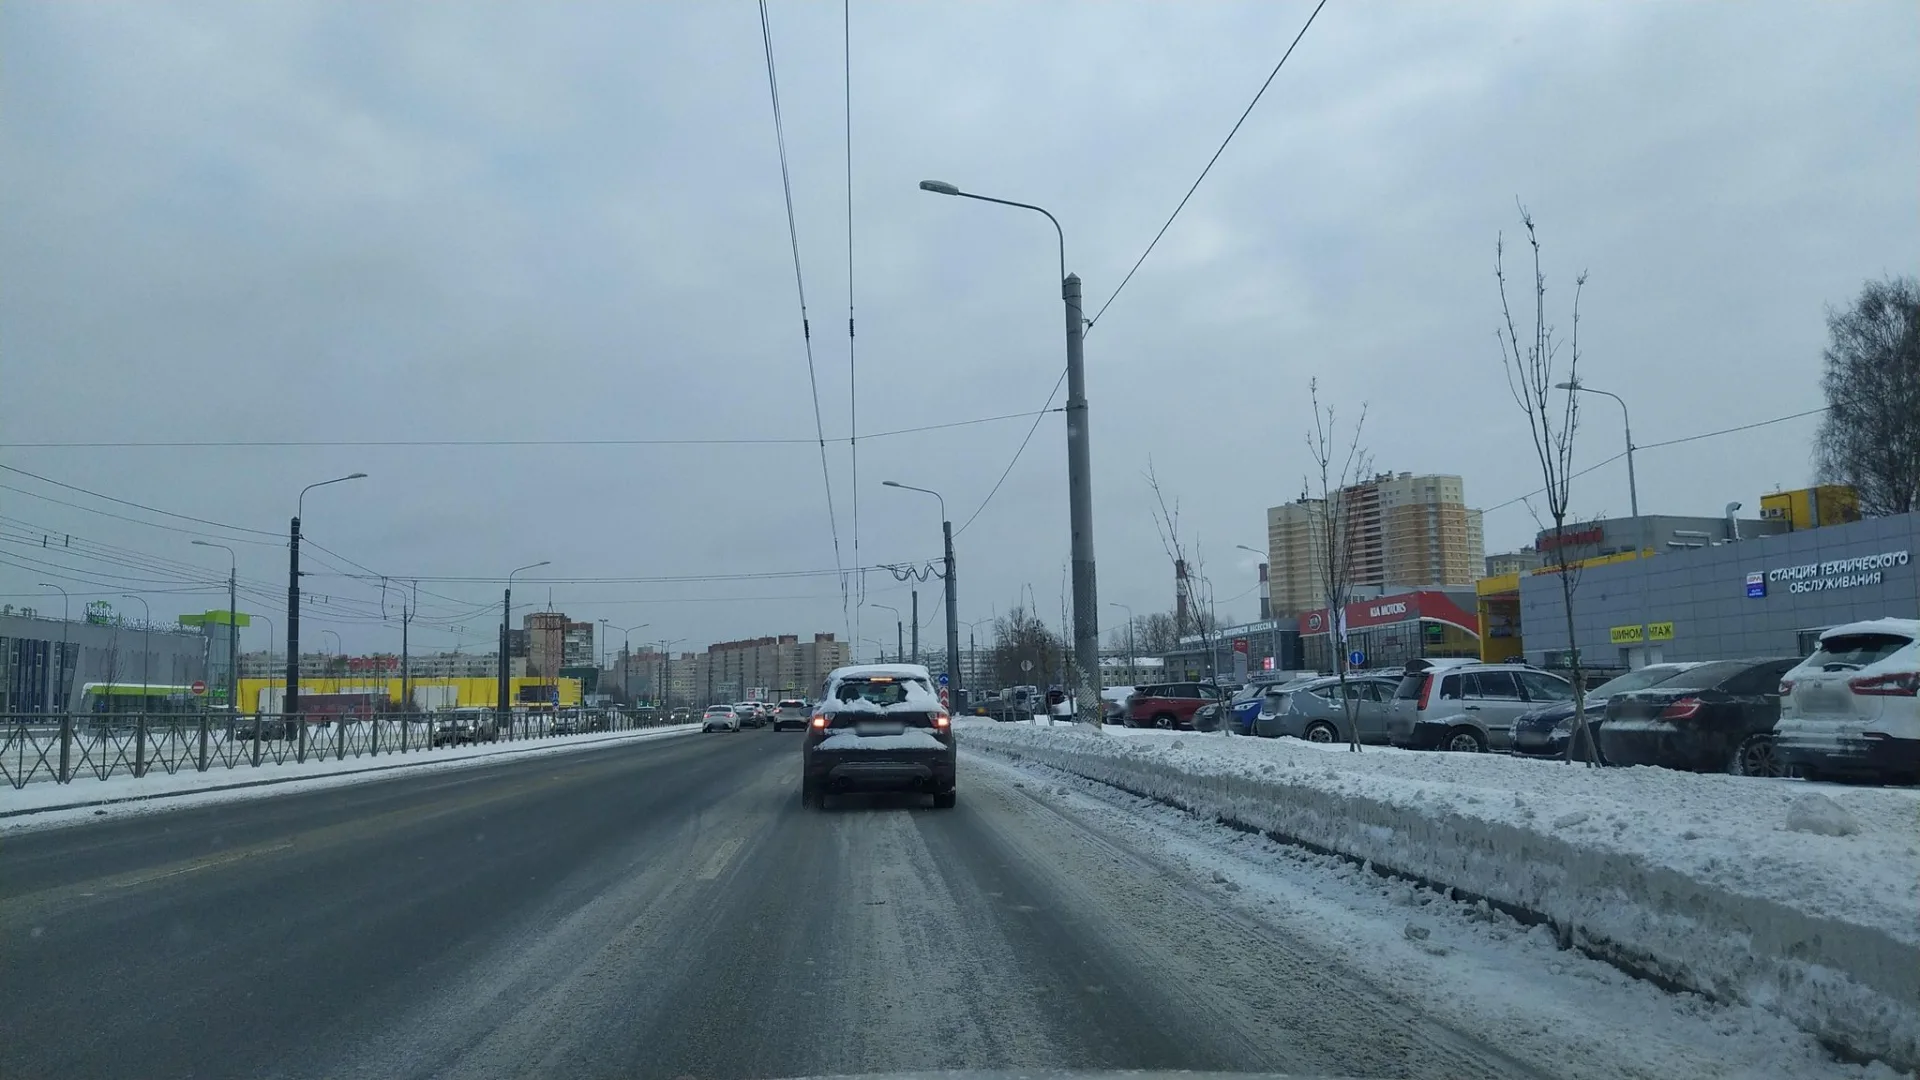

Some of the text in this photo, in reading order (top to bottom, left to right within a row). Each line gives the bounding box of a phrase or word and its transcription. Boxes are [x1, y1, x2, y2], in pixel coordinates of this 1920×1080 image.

[1769, 550, 1909, 582] СТАНЦИЯ ТЕХНИЧЕСКОГО
[1789, 571, 1882, 594] ОБСЛУЖИВАНИЯ
[1381, 602, 1407, 616] MOTORS
[1612, 624, 1672, 640] ШИНОМНТАЖ
